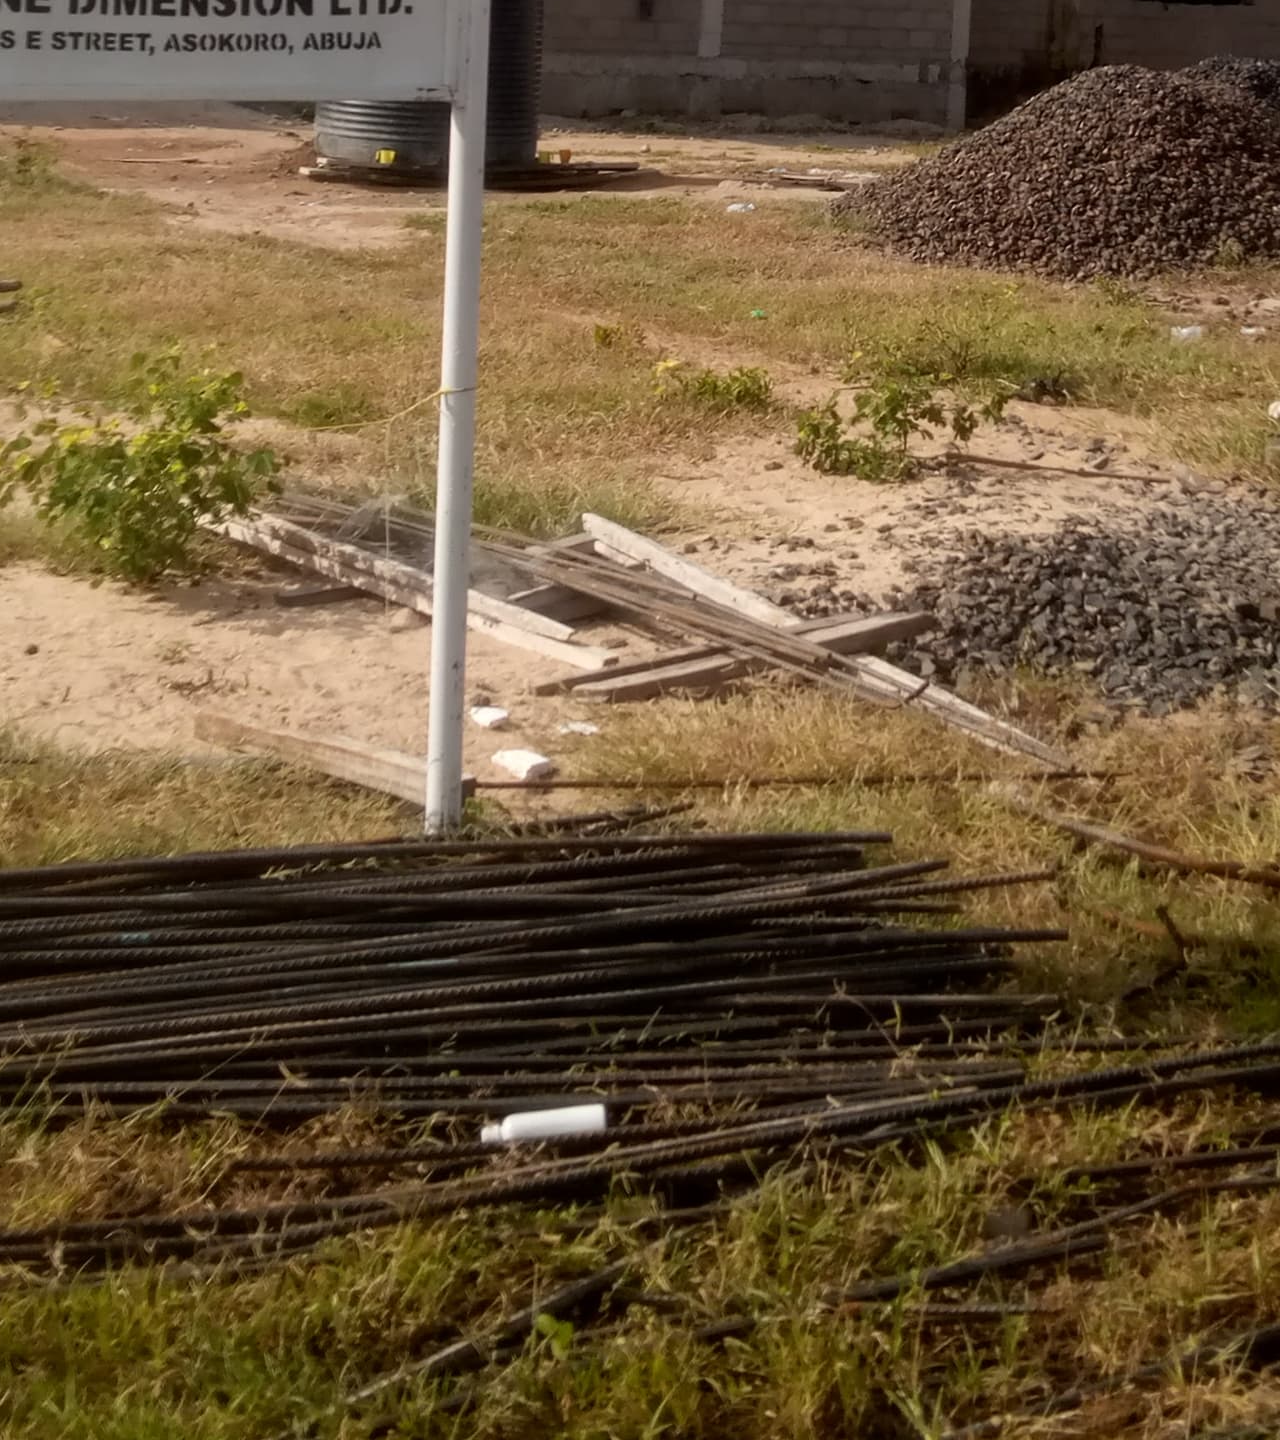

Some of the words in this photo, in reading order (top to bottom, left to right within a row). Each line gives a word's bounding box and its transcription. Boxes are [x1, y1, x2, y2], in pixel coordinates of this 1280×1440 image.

[51, 31, 156, 56] STREET,
[163, 32, 294, 55] ASOKORO,
[302, 31, 383, 51] ABUJA
